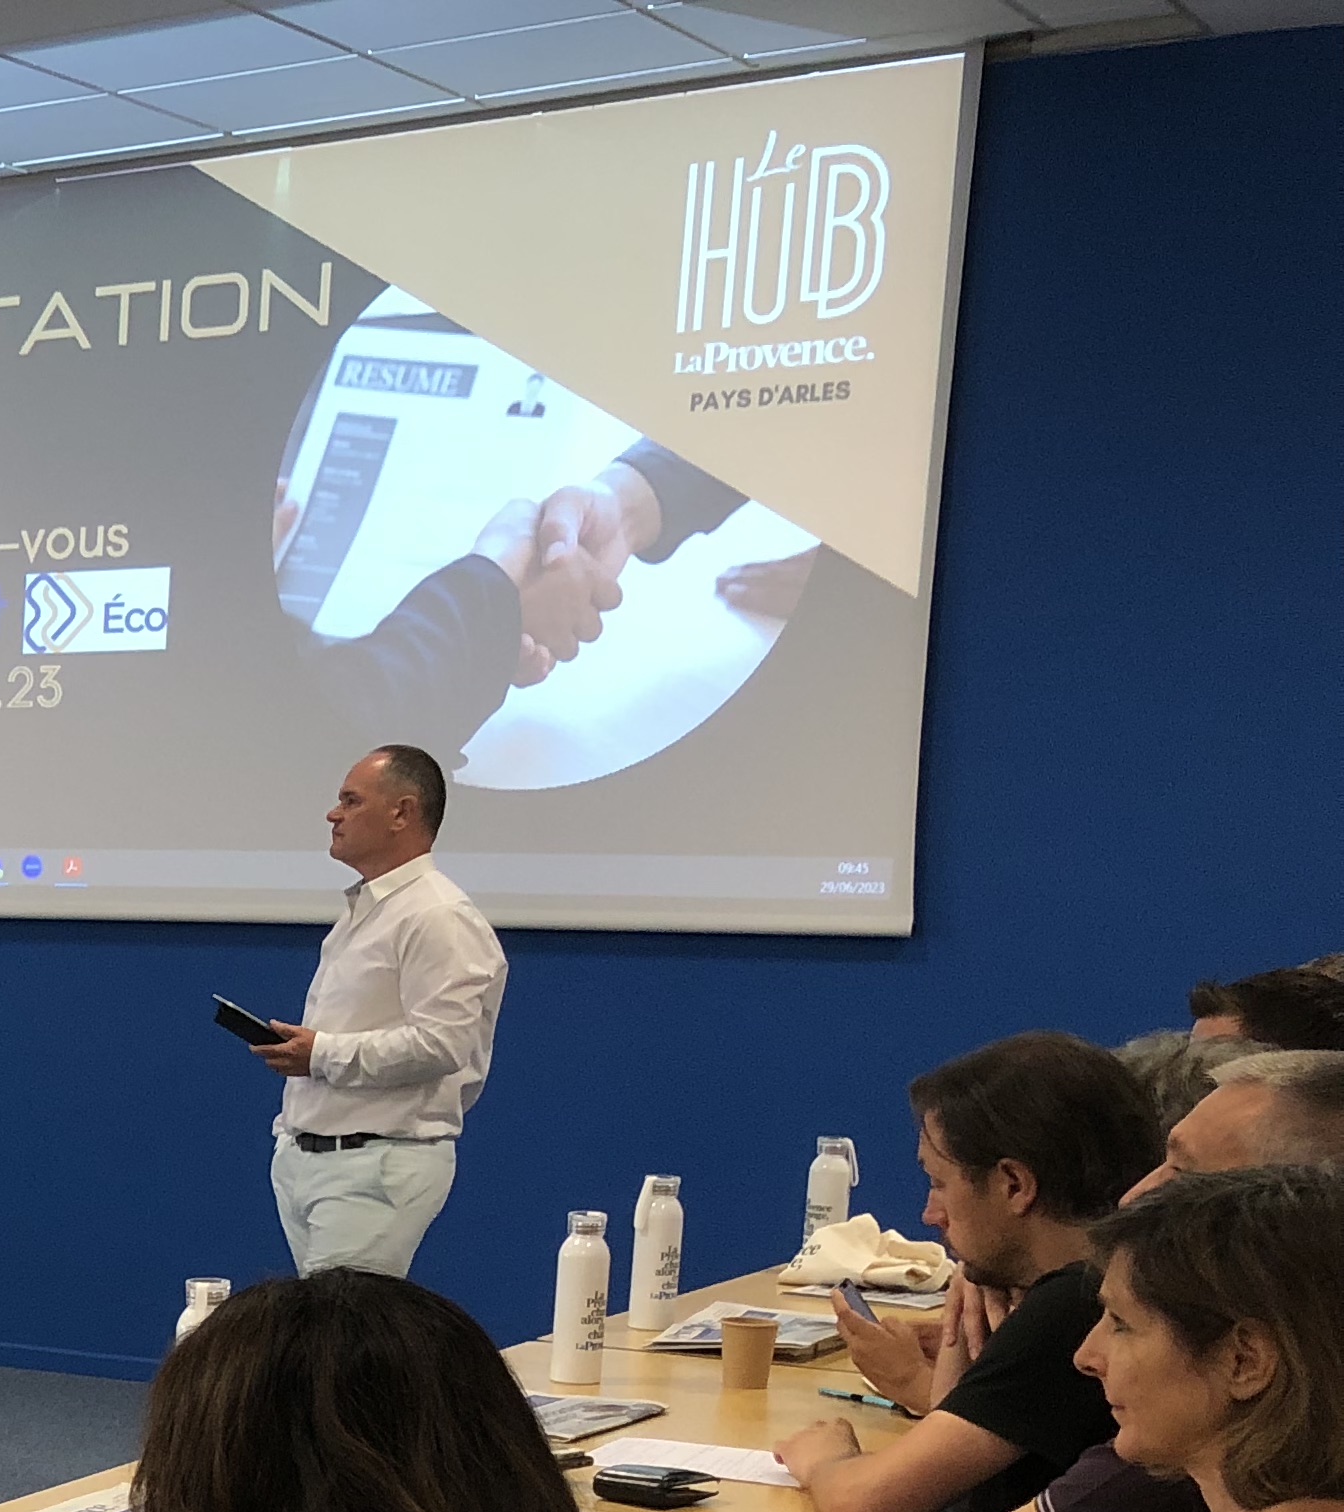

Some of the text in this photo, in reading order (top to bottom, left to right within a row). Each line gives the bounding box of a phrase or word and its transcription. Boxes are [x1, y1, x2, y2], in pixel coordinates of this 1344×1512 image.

[746, 129, 806, 182] Le
[676, 143, 891, 333] HUB
[340, 360, 460, 394] RESUME
[689, 379, 852, 412] PAYS D'ARLES
[102, 593, 168, 635] Éco
[838, 861, 869, 875] 09:45
[820, 881, 885, 894] 29/06/2023
